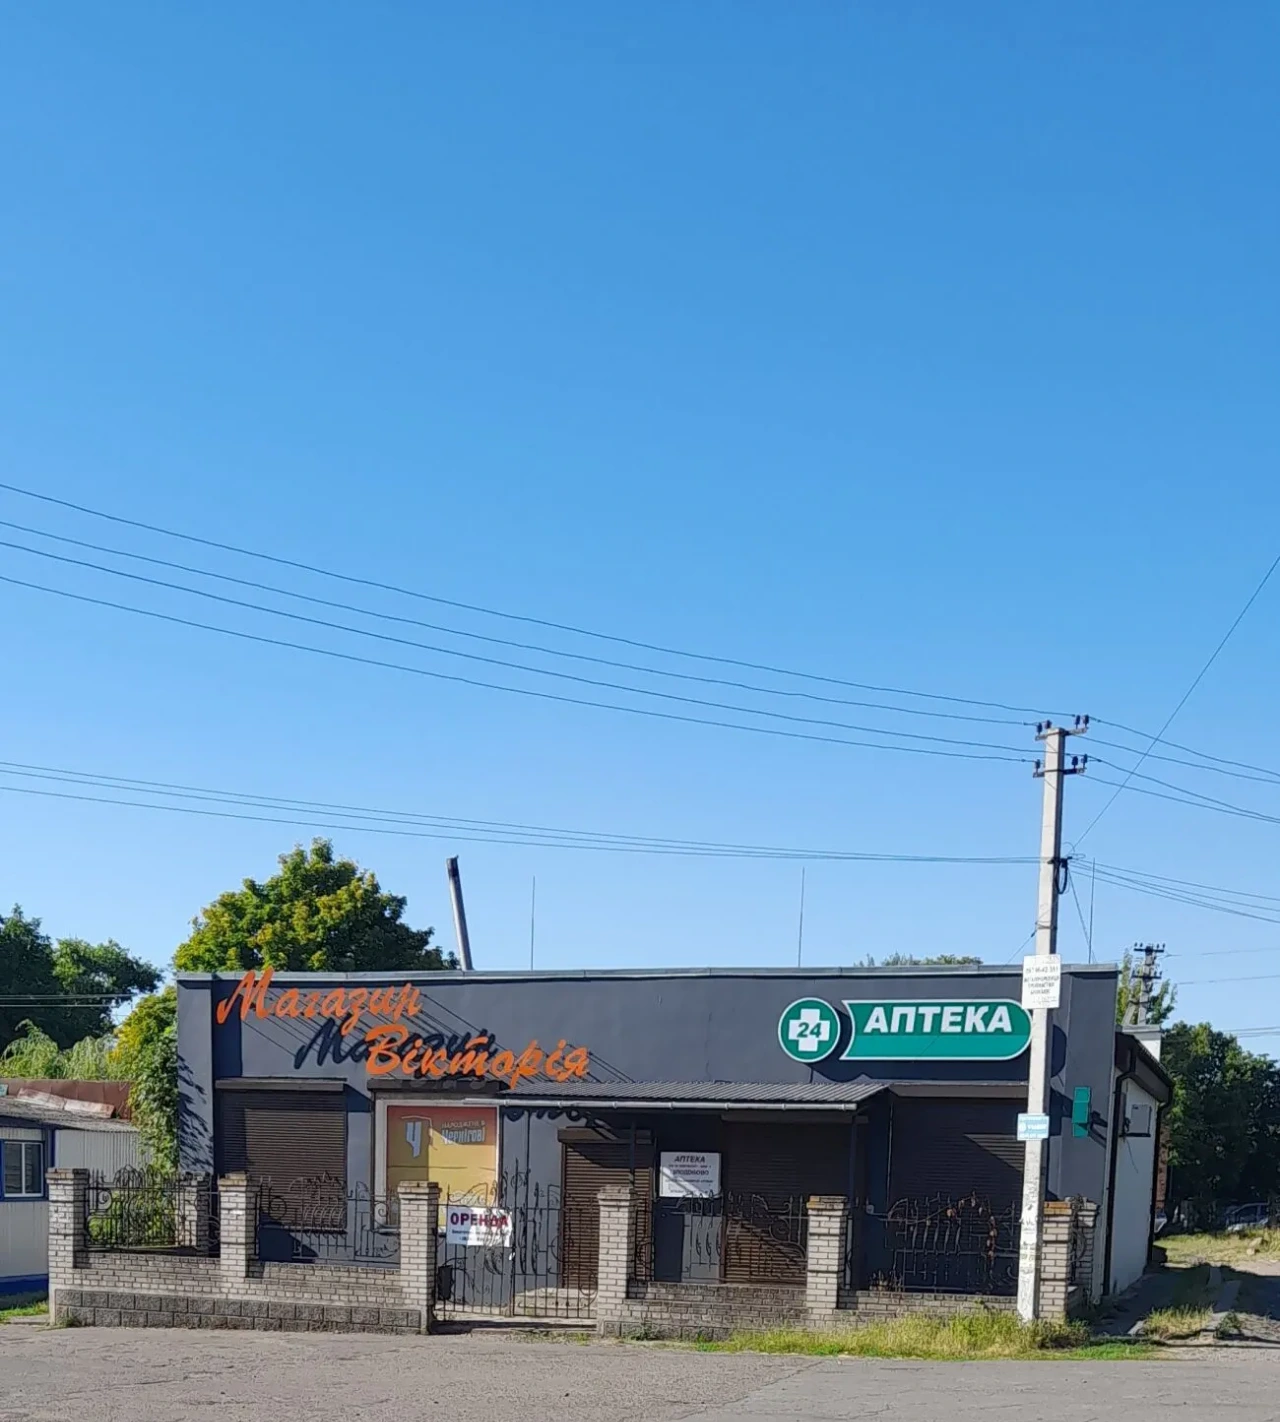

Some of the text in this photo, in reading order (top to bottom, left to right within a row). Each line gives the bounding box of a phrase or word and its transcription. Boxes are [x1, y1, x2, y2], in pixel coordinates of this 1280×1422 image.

[216, 967, 424, 1035] Магазин
[796, 1022, 822, 1038] 24
[863, 1006, 1012, 1033] АПТЕКА
[365, 1024, 590, 1089] Вікторія
[674, 1155, 706, 1163] АПТЕКА
[450, 1212, 508, 1228] ОРЕНДА
